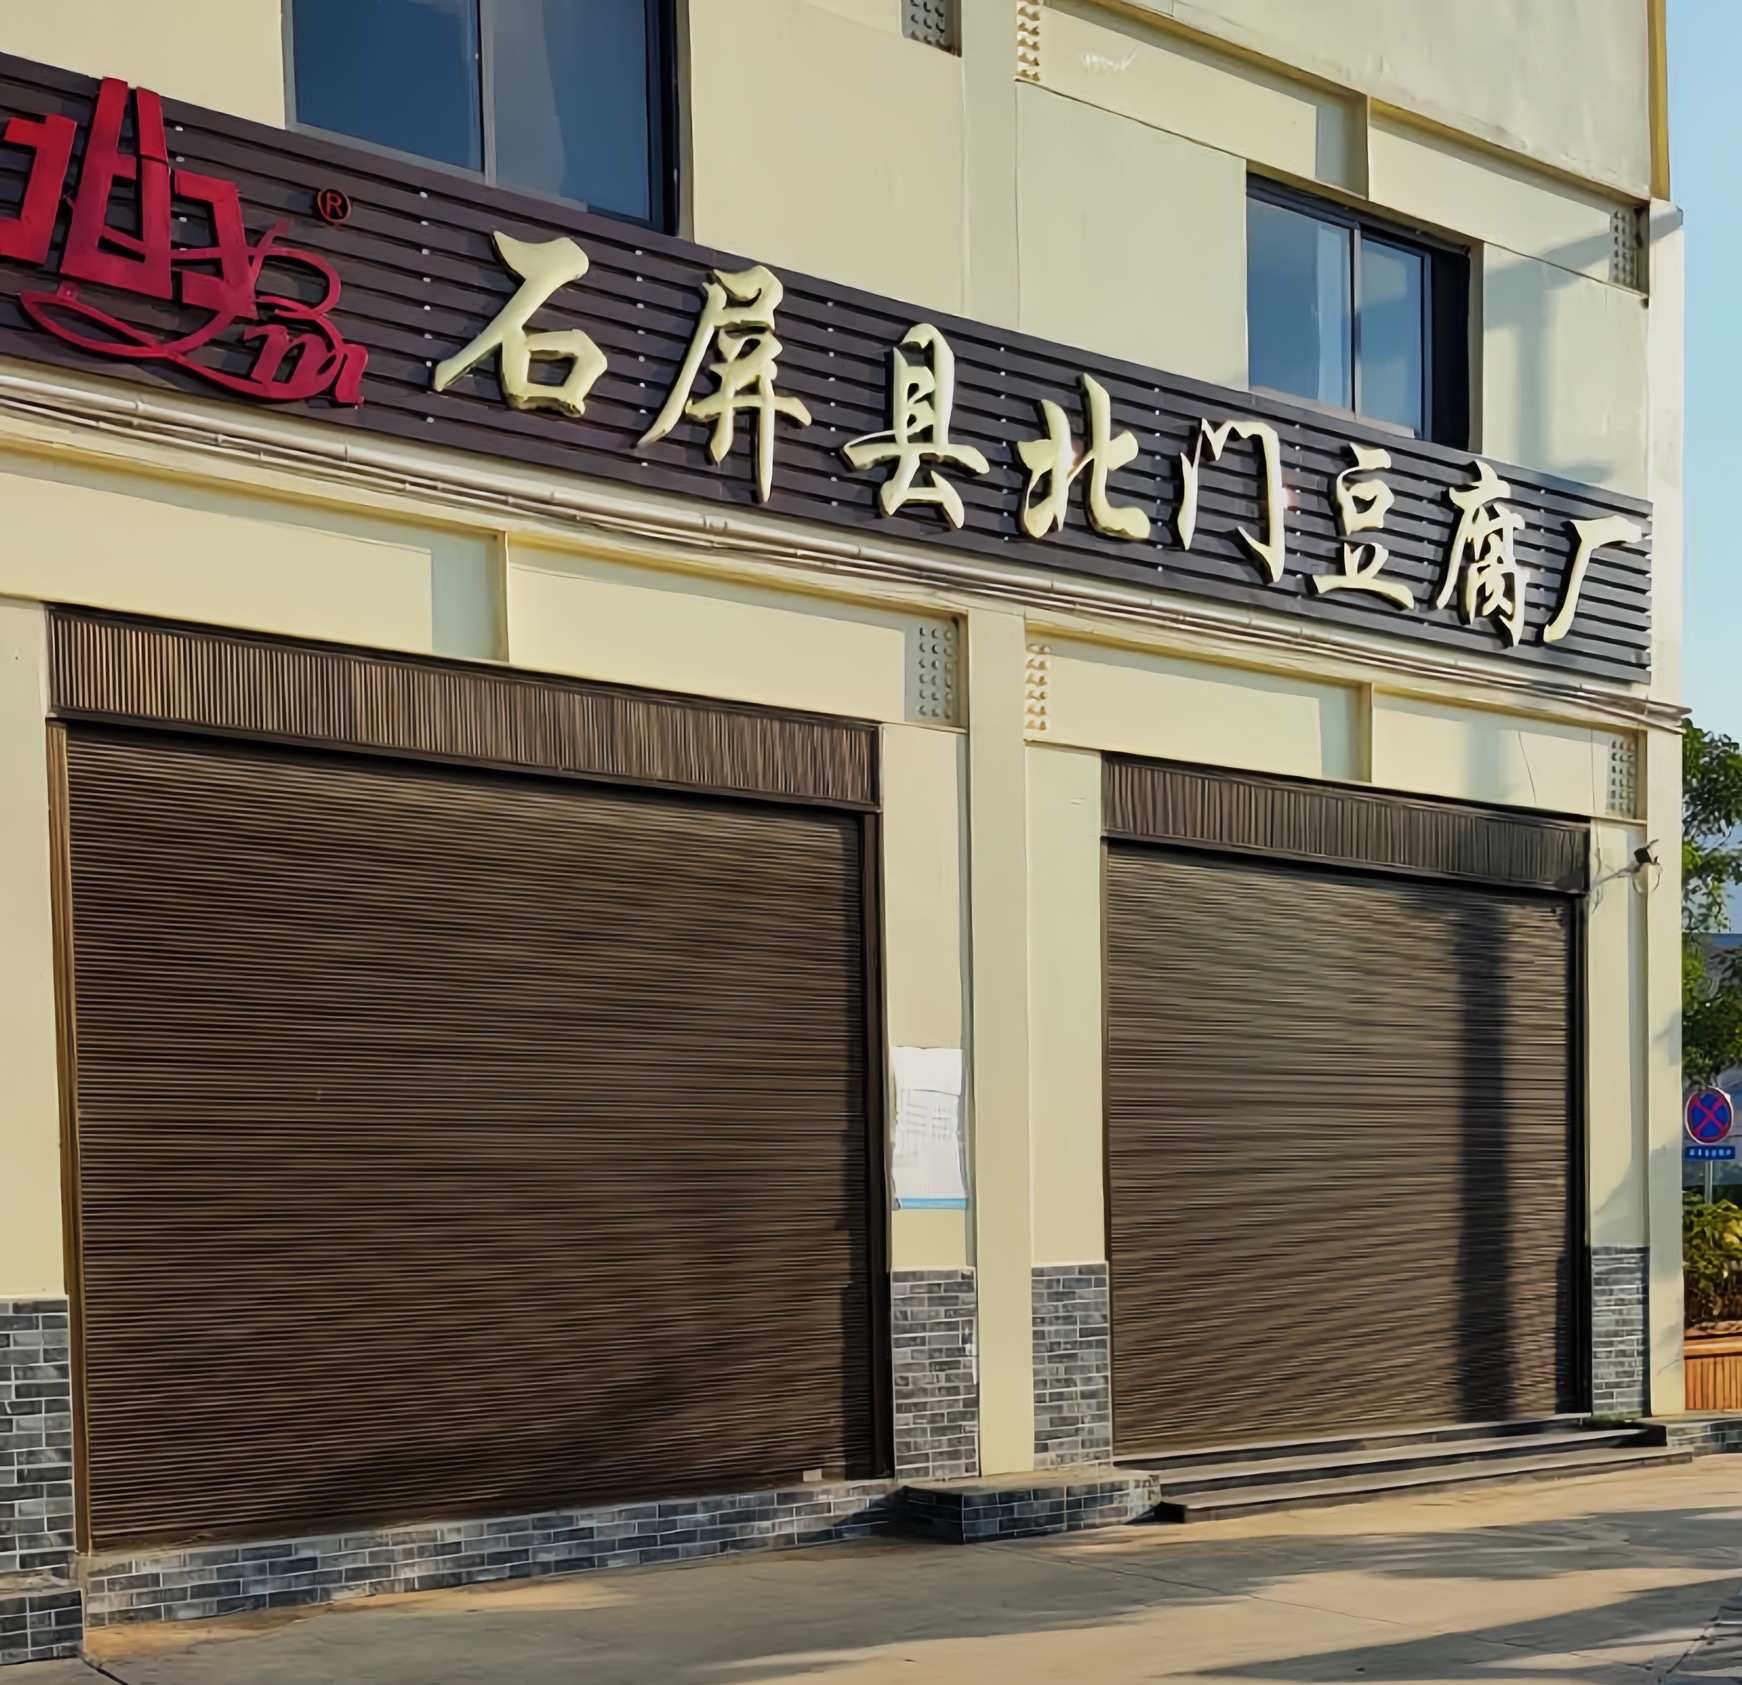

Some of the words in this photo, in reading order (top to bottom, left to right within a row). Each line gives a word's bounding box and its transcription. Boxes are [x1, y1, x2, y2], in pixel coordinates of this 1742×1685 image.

[433, 231, 1643, 647] 石屏县北门豆腐厂
